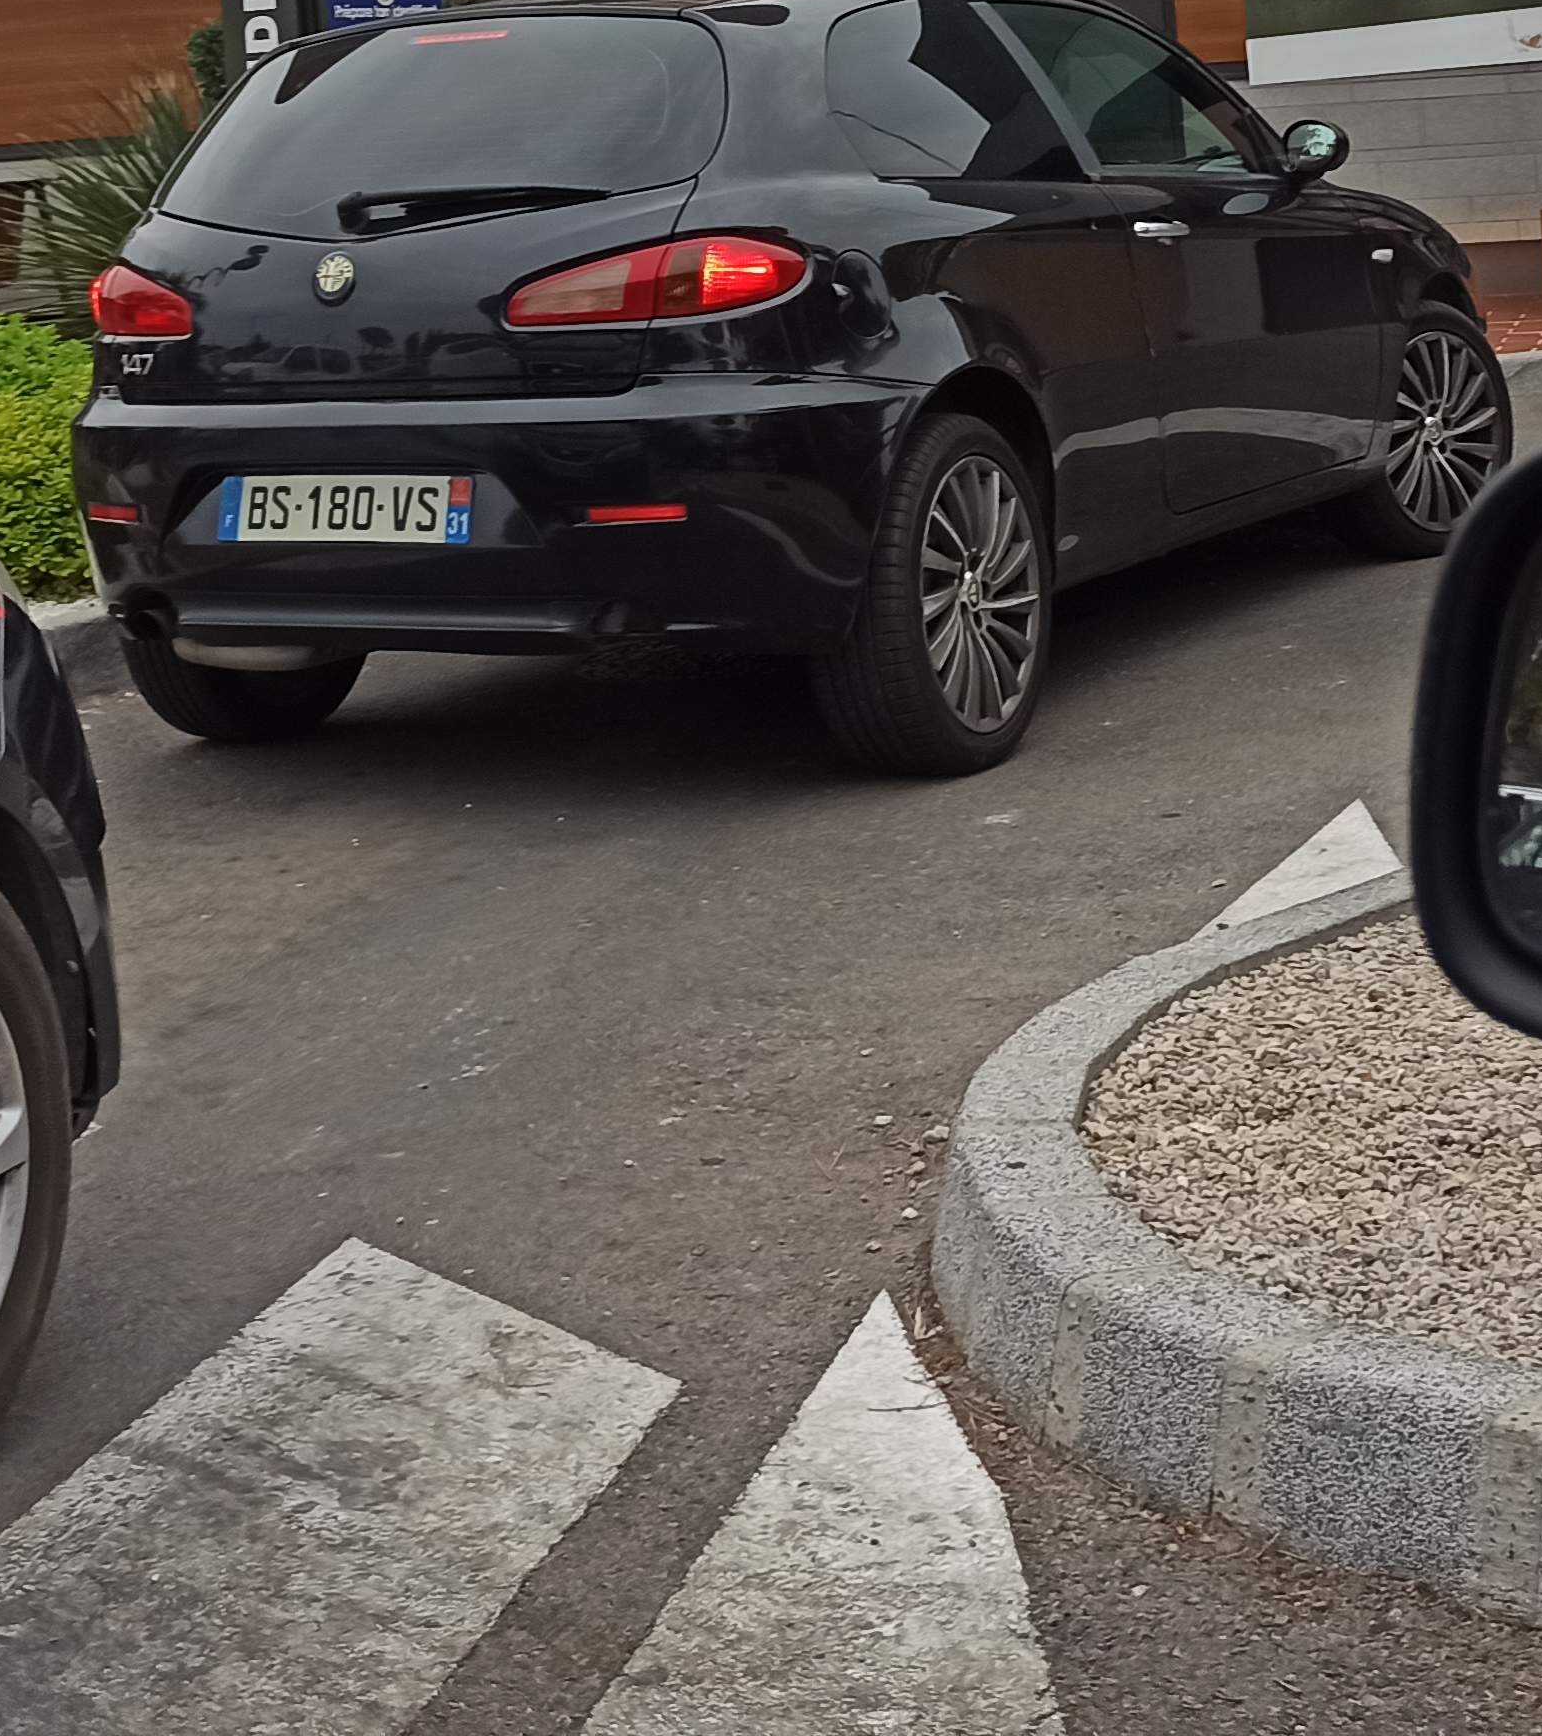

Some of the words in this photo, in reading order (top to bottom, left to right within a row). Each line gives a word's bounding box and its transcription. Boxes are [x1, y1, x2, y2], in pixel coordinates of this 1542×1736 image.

[120, 353, 155, 375] 147
[248, 485, 439, 531] BS-180-VS
[224, 514, 234, 527] F
[447, 512, 469, 535] 31
